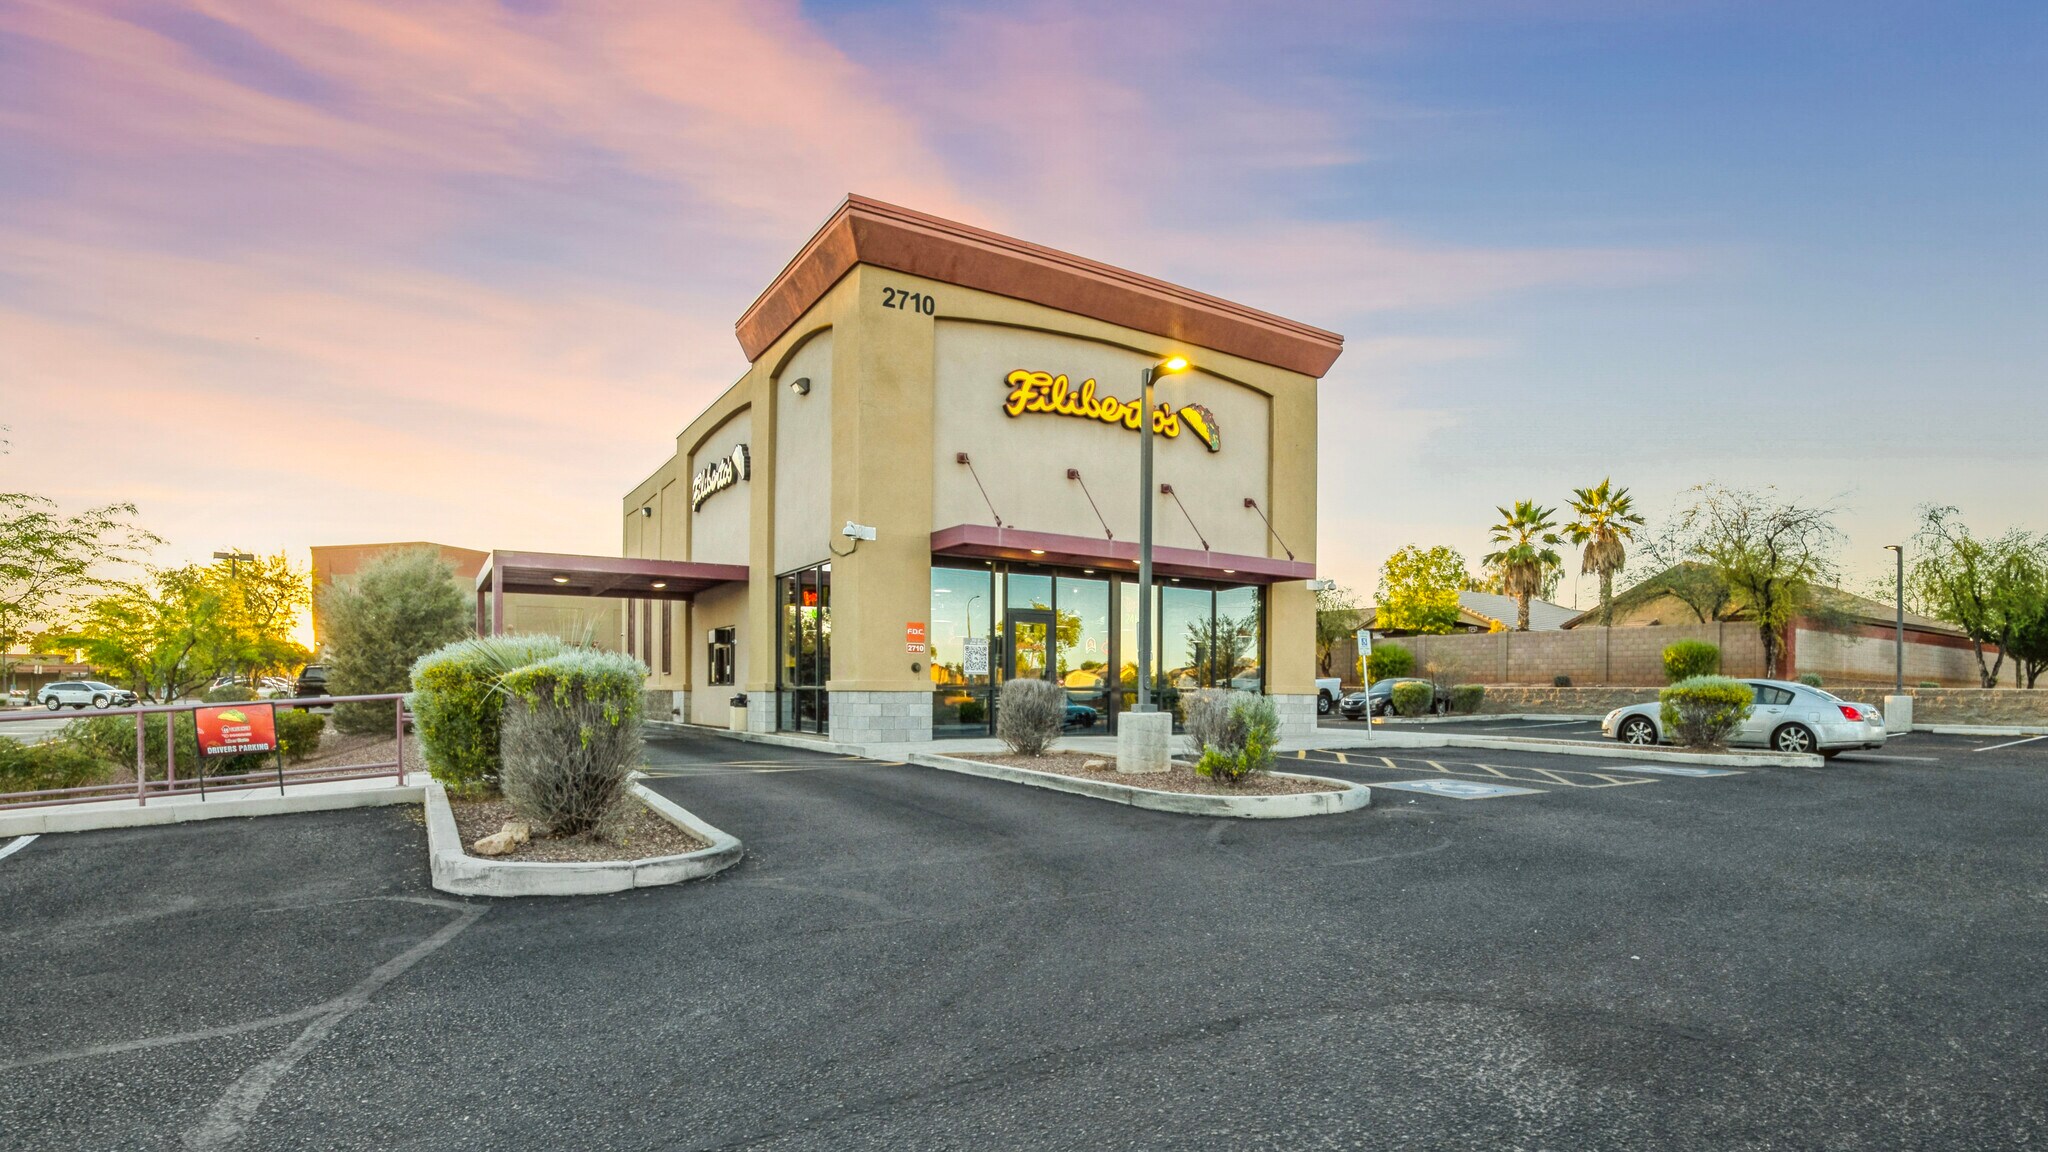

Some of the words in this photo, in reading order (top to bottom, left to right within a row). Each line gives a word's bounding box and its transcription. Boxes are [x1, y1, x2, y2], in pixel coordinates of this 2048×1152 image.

[882, 286, 935, 316] 2710
[907, 644, 924, 652] 2710
[207, 745, 237, 754] DRIVERS
[238, 743, 269, 752] PARKING
